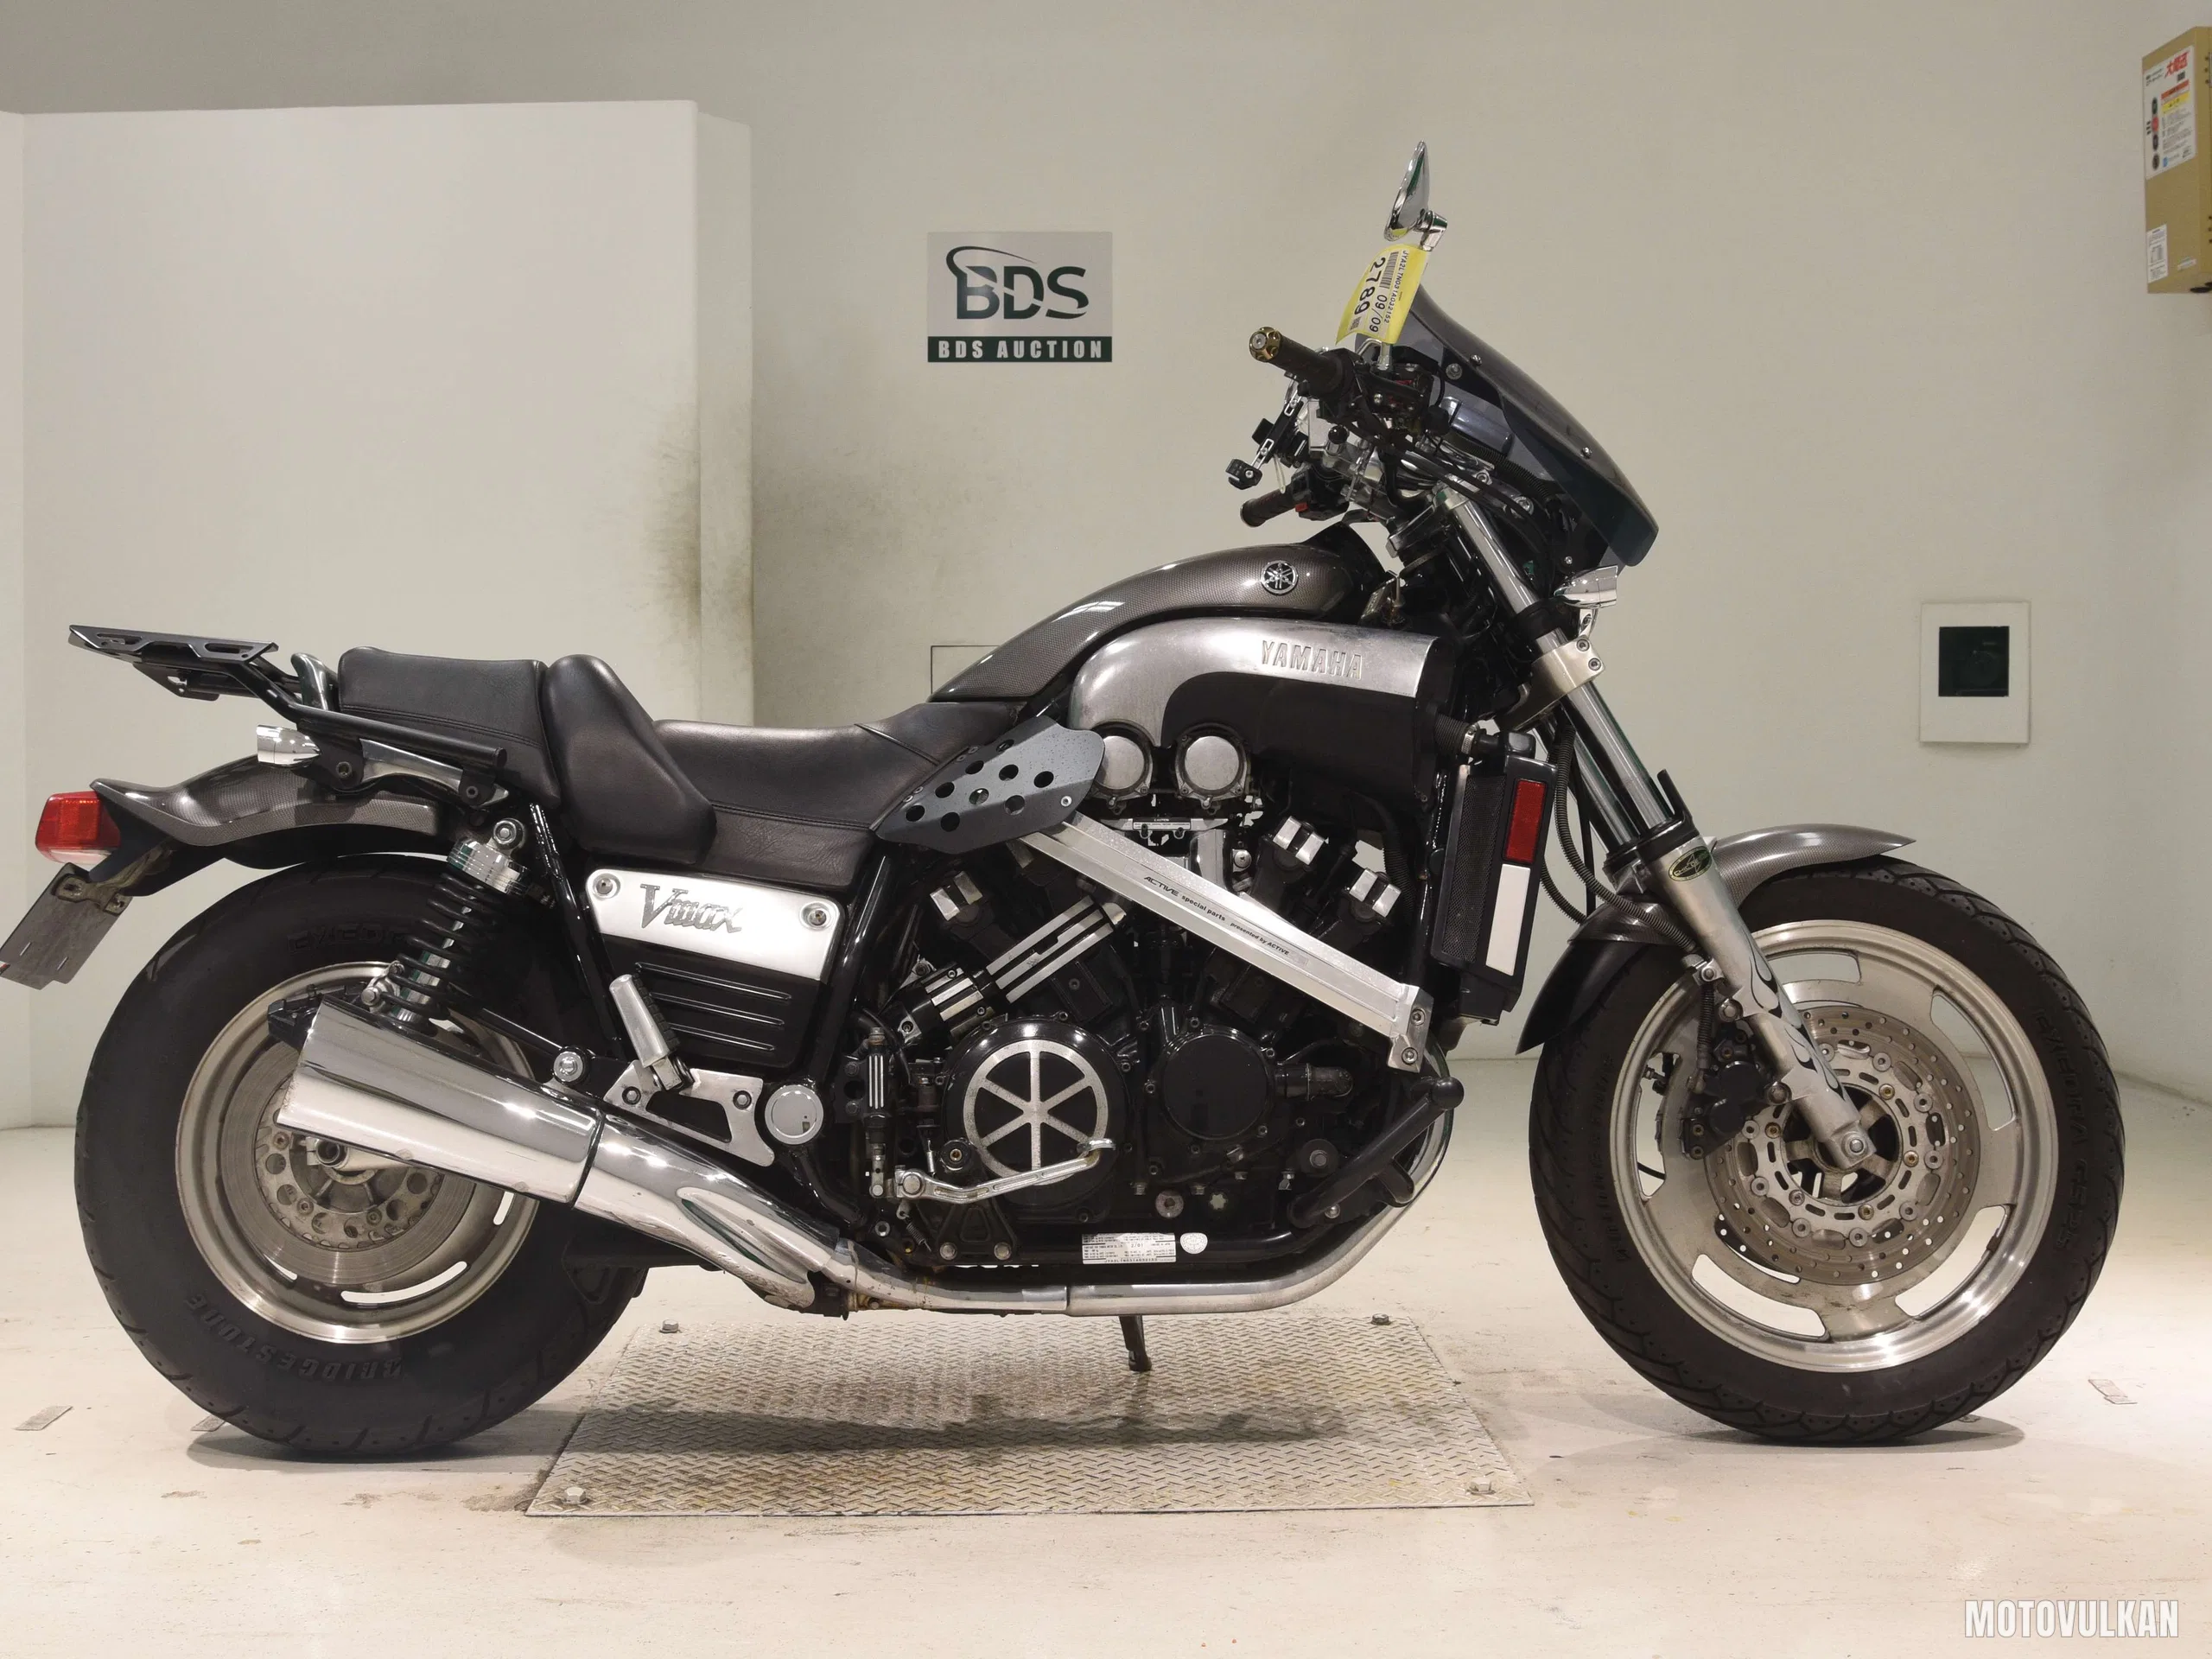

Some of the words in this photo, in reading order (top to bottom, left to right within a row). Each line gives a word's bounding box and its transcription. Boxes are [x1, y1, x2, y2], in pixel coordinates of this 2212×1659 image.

[946, 245, 1090, 320] BDS
[1354, 257, 1386, 315] 2789
[1369, 294, 1389, 333] 09/09
[938, 340, 984, 359] BDS
[996, 340, 1103, 359] AUCTION
[1262, 640, 1363, 680] YAMAHA
[1143, 875, 1179, 897] ACTIVE
[1181, 894, 1207, 911] special
[1206, 908, 1226, 922] parts
[1230, 922, 1260, 939] presented
[1259, 935, 1267, 944] by
[1267, 941, 1290, 956] ACTIVE
[183, 1294, 404, 1382] BRIDGESTONE
